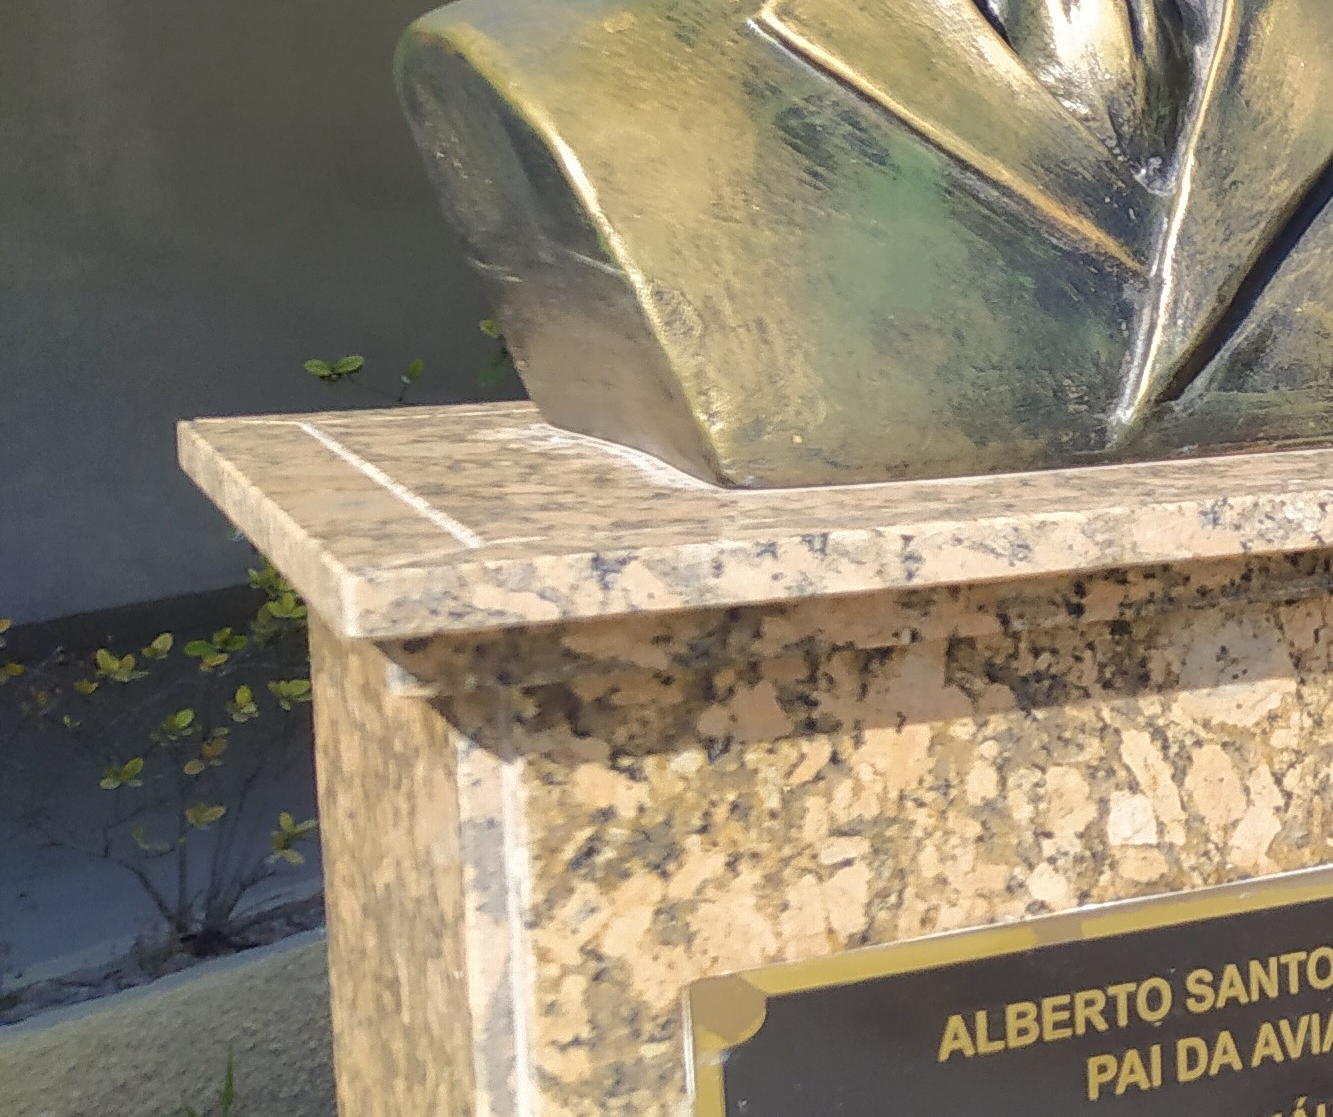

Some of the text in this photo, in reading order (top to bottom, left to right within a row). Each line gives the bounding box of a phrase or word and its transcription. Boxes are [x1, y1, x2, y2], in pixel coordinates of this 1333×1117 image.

[937, 977, 1173, 1064] ALBERTO
[1086, 1043, 1162, 1102] PAI
[1176, 1030, 1243, 1083] DA
